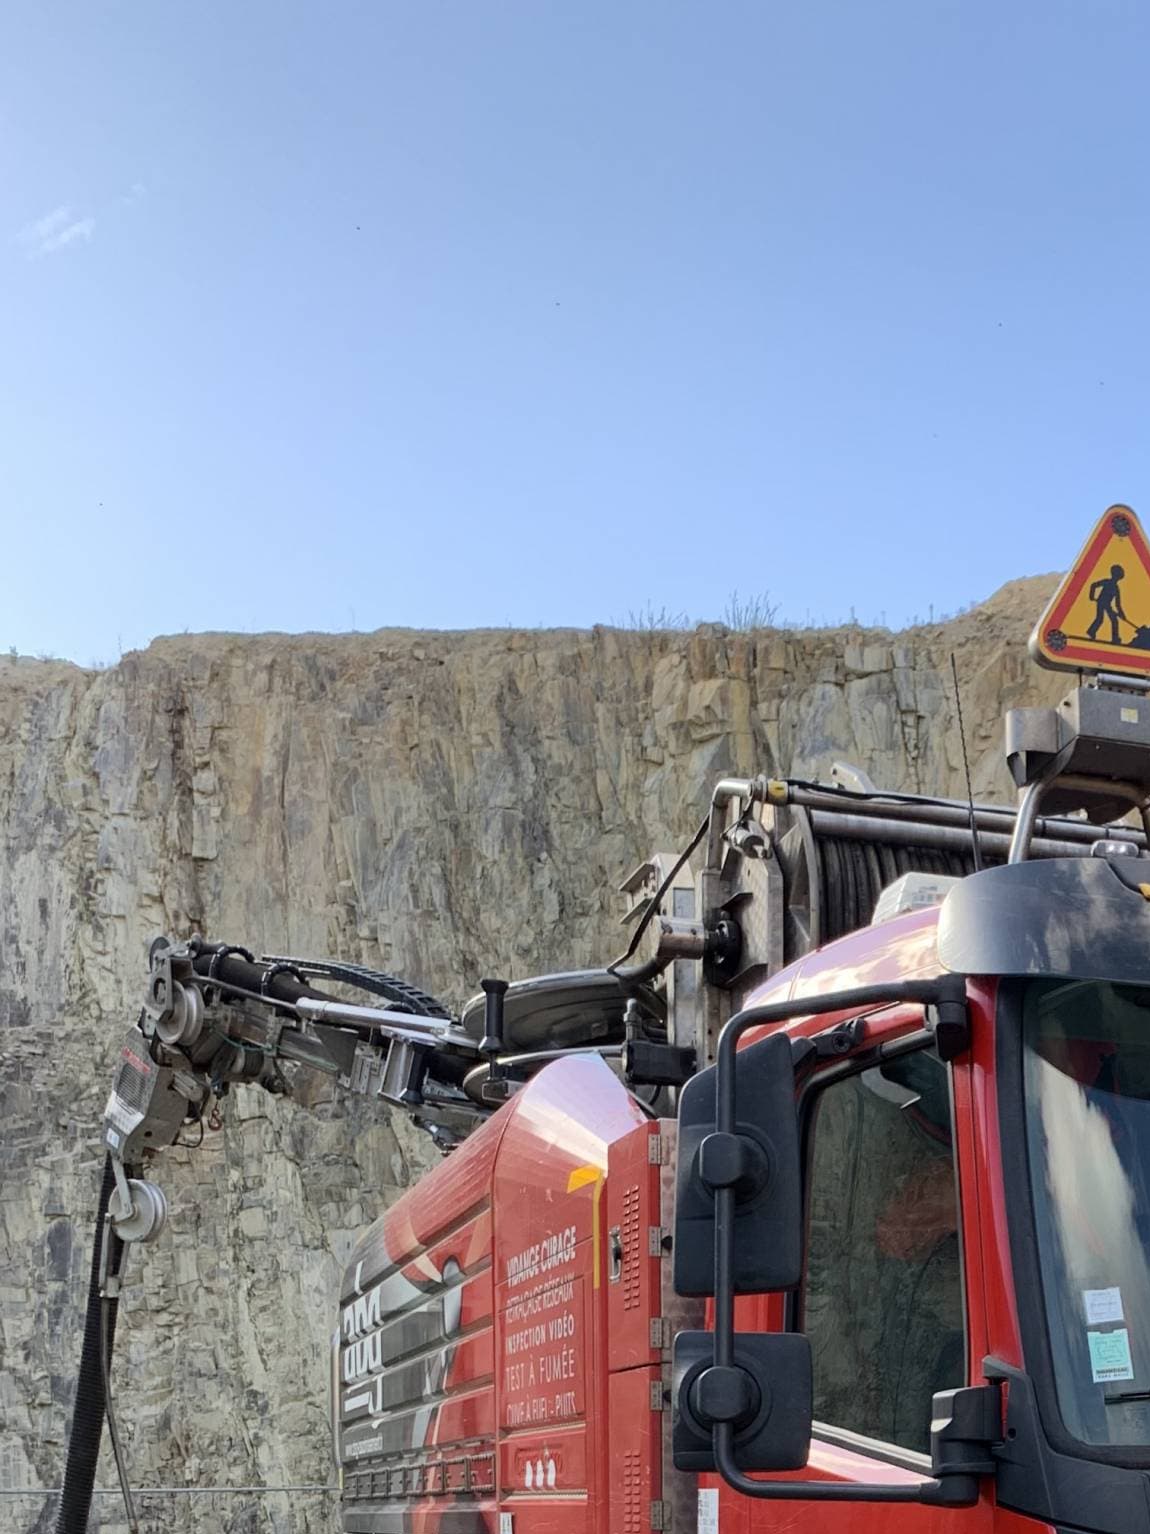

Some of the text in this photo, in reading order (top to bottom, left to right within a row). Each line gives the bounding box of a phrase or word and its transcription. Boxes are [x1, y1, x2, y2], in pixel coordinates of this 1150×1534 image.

[507, 1225, 576, 1288] VIDANGE CURAGE
[506, 1310, 575, 1355] INSPECTION VIDÉO
[506, 1344, 575, 1392] TEST À FUMÉE
